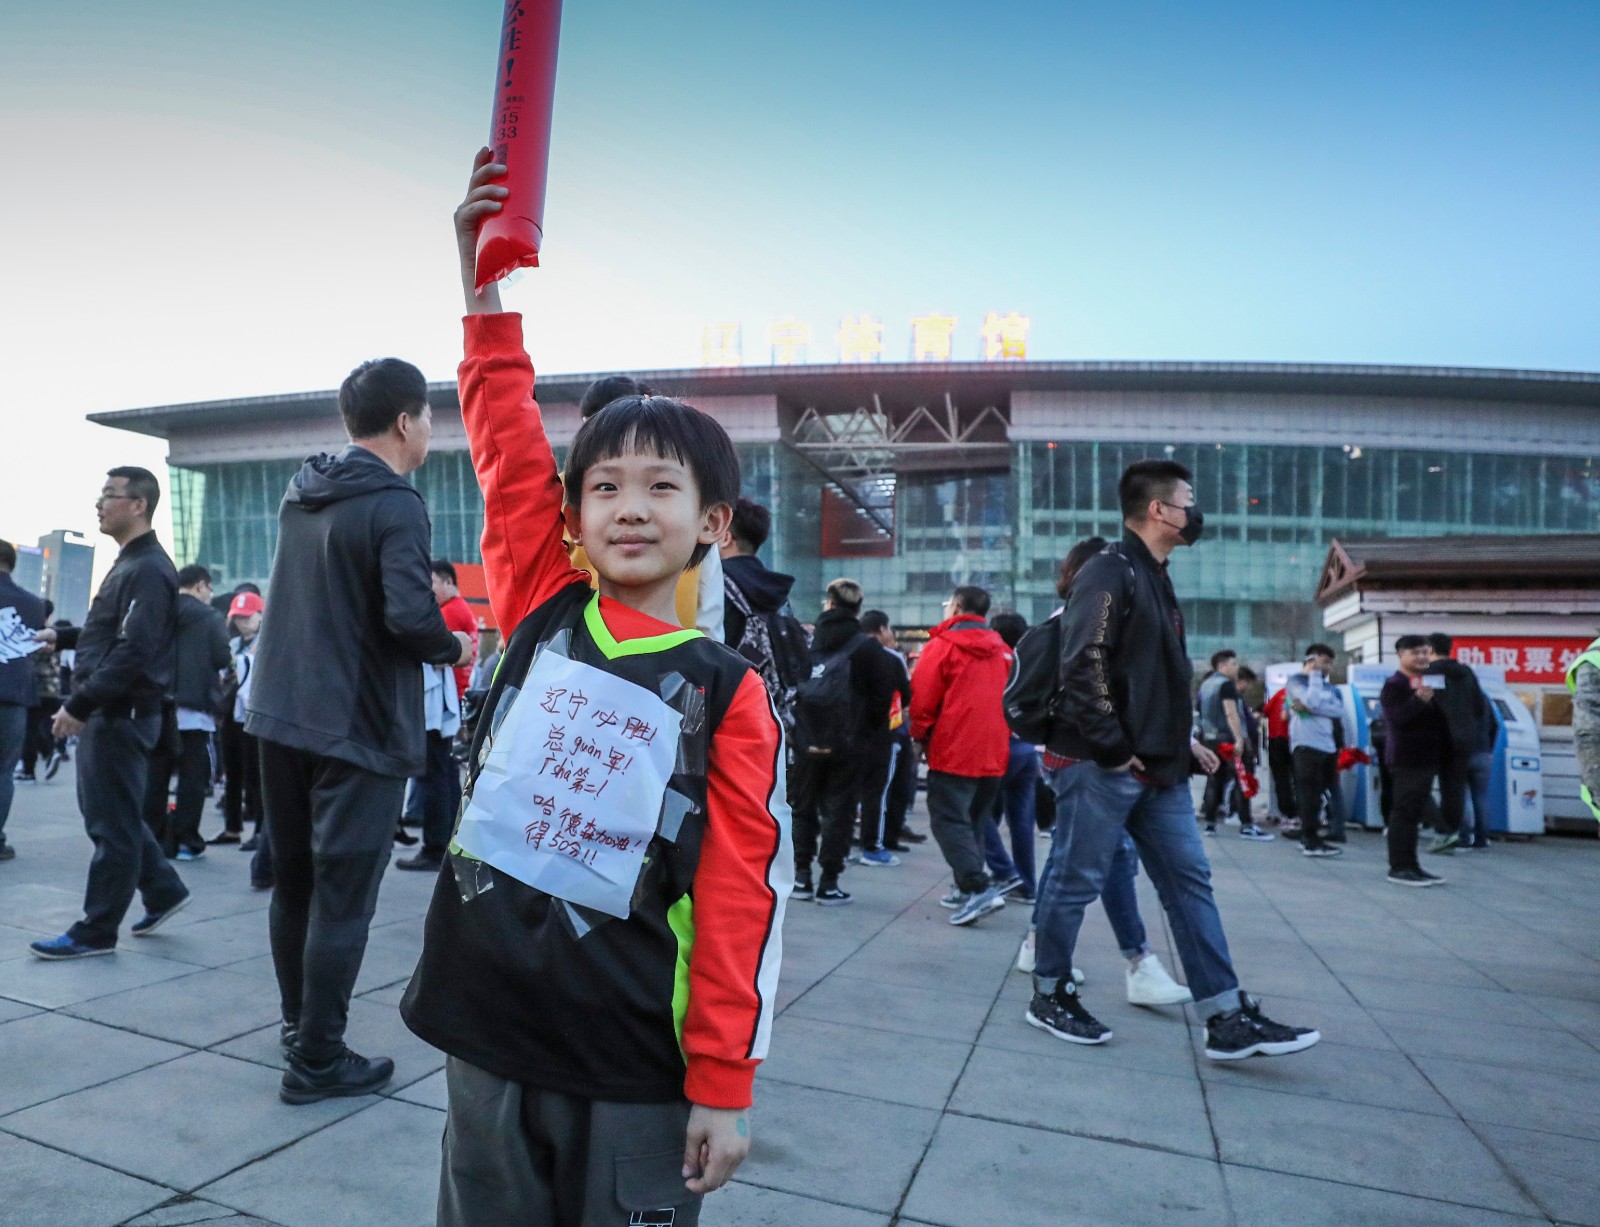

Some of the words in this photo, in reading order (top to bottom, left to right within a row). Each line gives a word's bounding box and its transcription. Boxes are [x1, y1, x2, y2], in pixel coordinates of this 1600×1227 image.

[701, 312, 1030, 365] 辽宁体育馆
